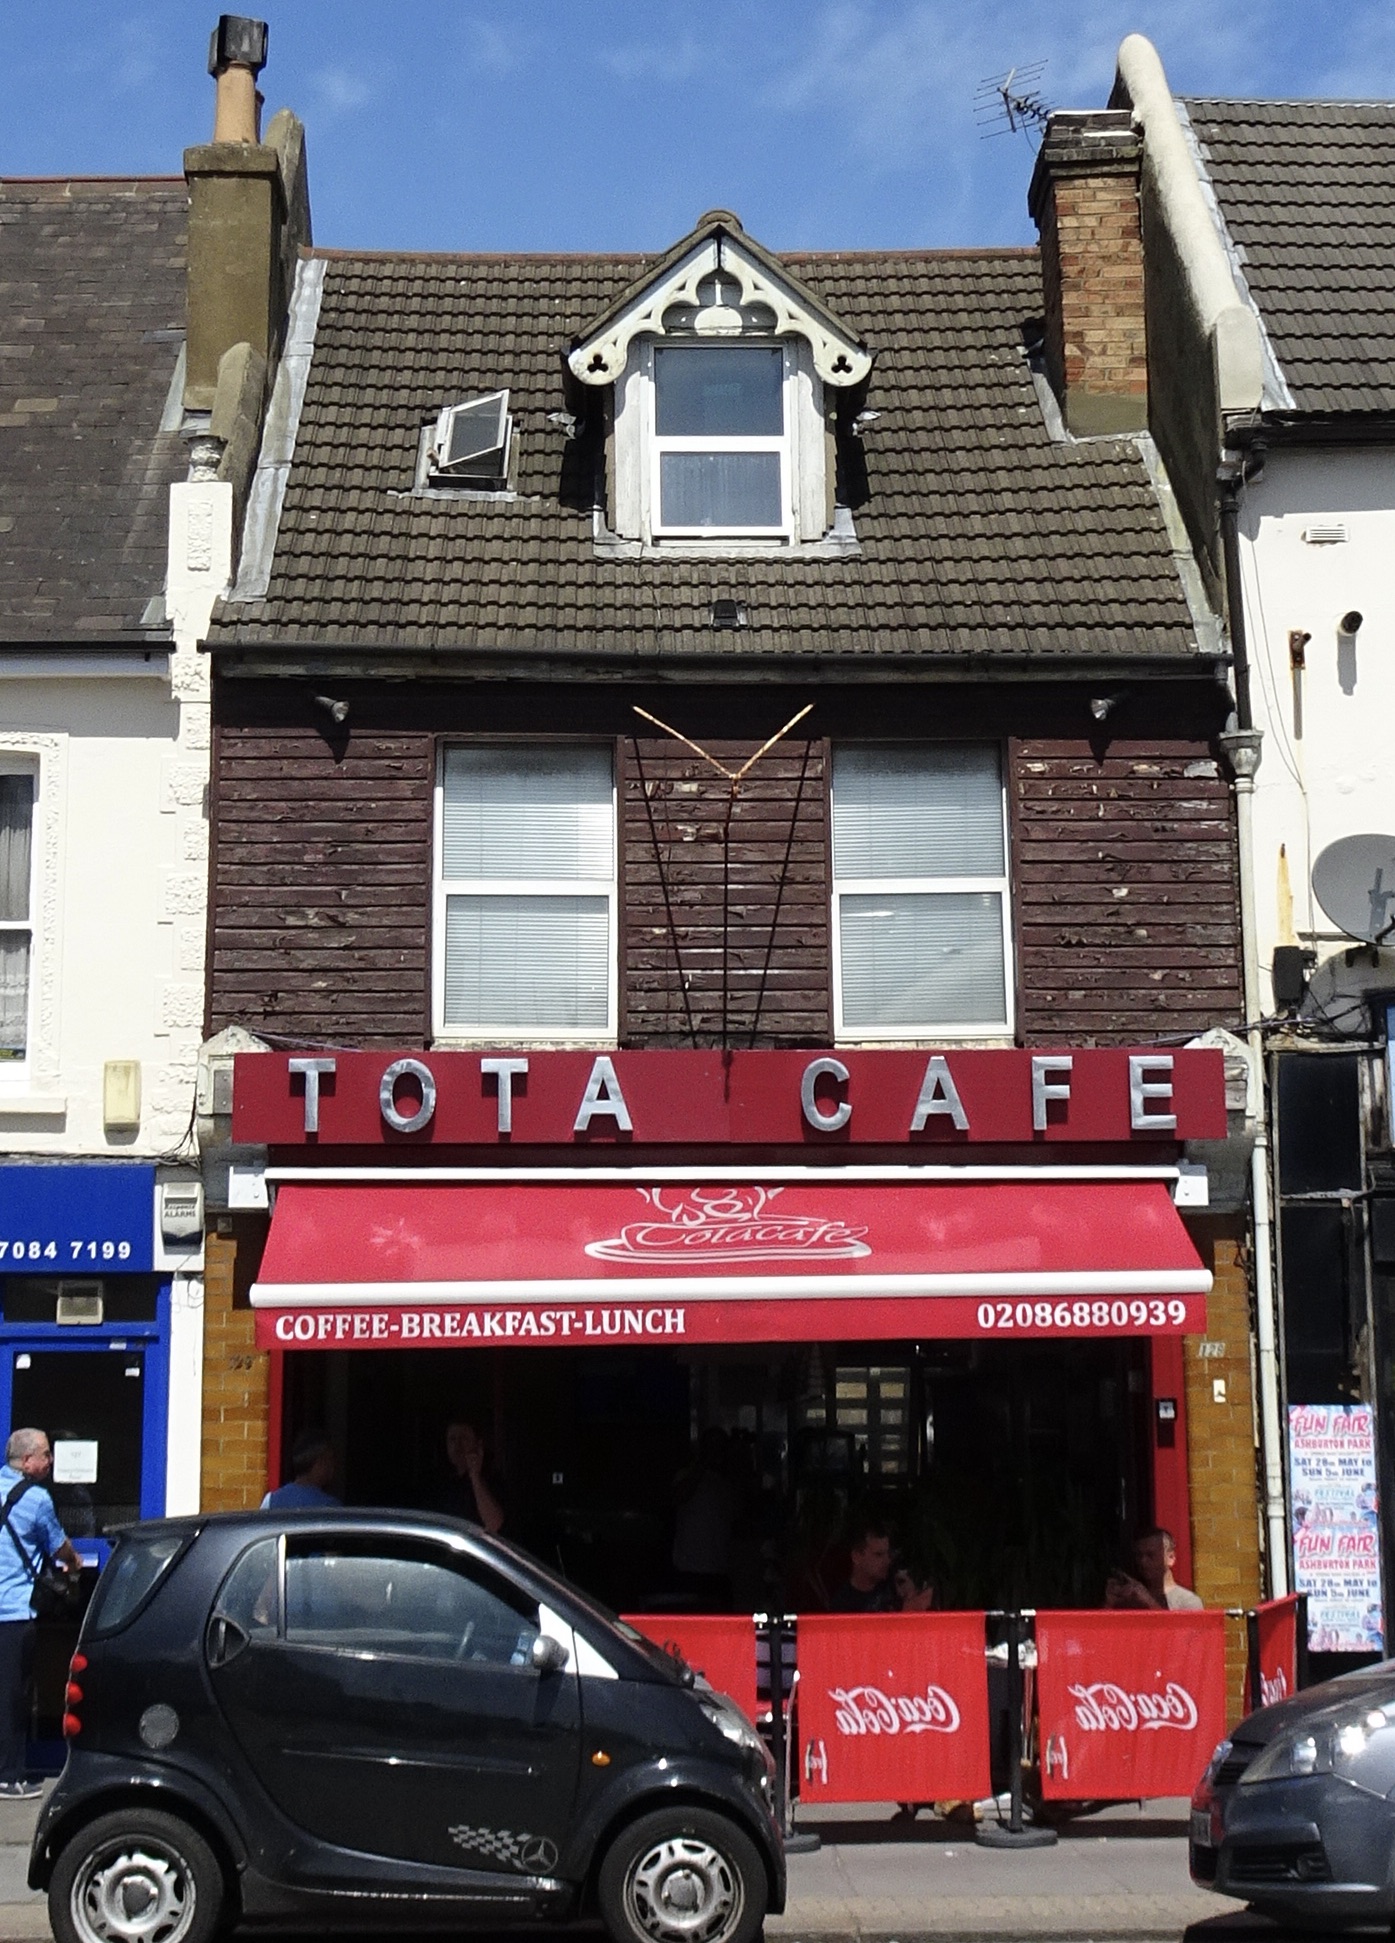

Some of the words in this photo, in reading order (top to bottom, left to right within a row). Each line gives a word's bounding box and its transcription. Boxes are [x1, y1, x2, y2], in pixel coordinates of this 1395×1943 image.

[287, 1055, 634, 1134] TOTA
[800, 1054, 1178, 1133] CAFE
[0, 1240, 58, 1260] 7084
[70, 1240, 132, 1260] 7199
[977, 1300, 1187, 1329] 02086880939
[1294, 1414, 1327, 1434] FUN
[1333, 1412, 1370, 1435] FAIR
[1294, 1439, 1345, 1449] ASHBURTON
[1347, 1438, 1371, 1449] PARK
[1294, 1458, 1312, 1467] SAT
[1338, 1457, 1359, 1466] MAY
[1301, 1468, 1322, 1477] SUN
[1342, 1468, 1365, 1477] JUNE
[1299, 1534, 1331, 1553] FUN
[1338, 1534, 1374, 1554] FAIR
[1299, 1560, 1350, 1569] ASHBURTON
[1353, 1559, 1376, 1569] PARK
[1299, 1579, 1317, 1588] SAT
[1343, 1578, 1364, 1587] MAY
[1347, 1589, 1371, 1598] JUNE
